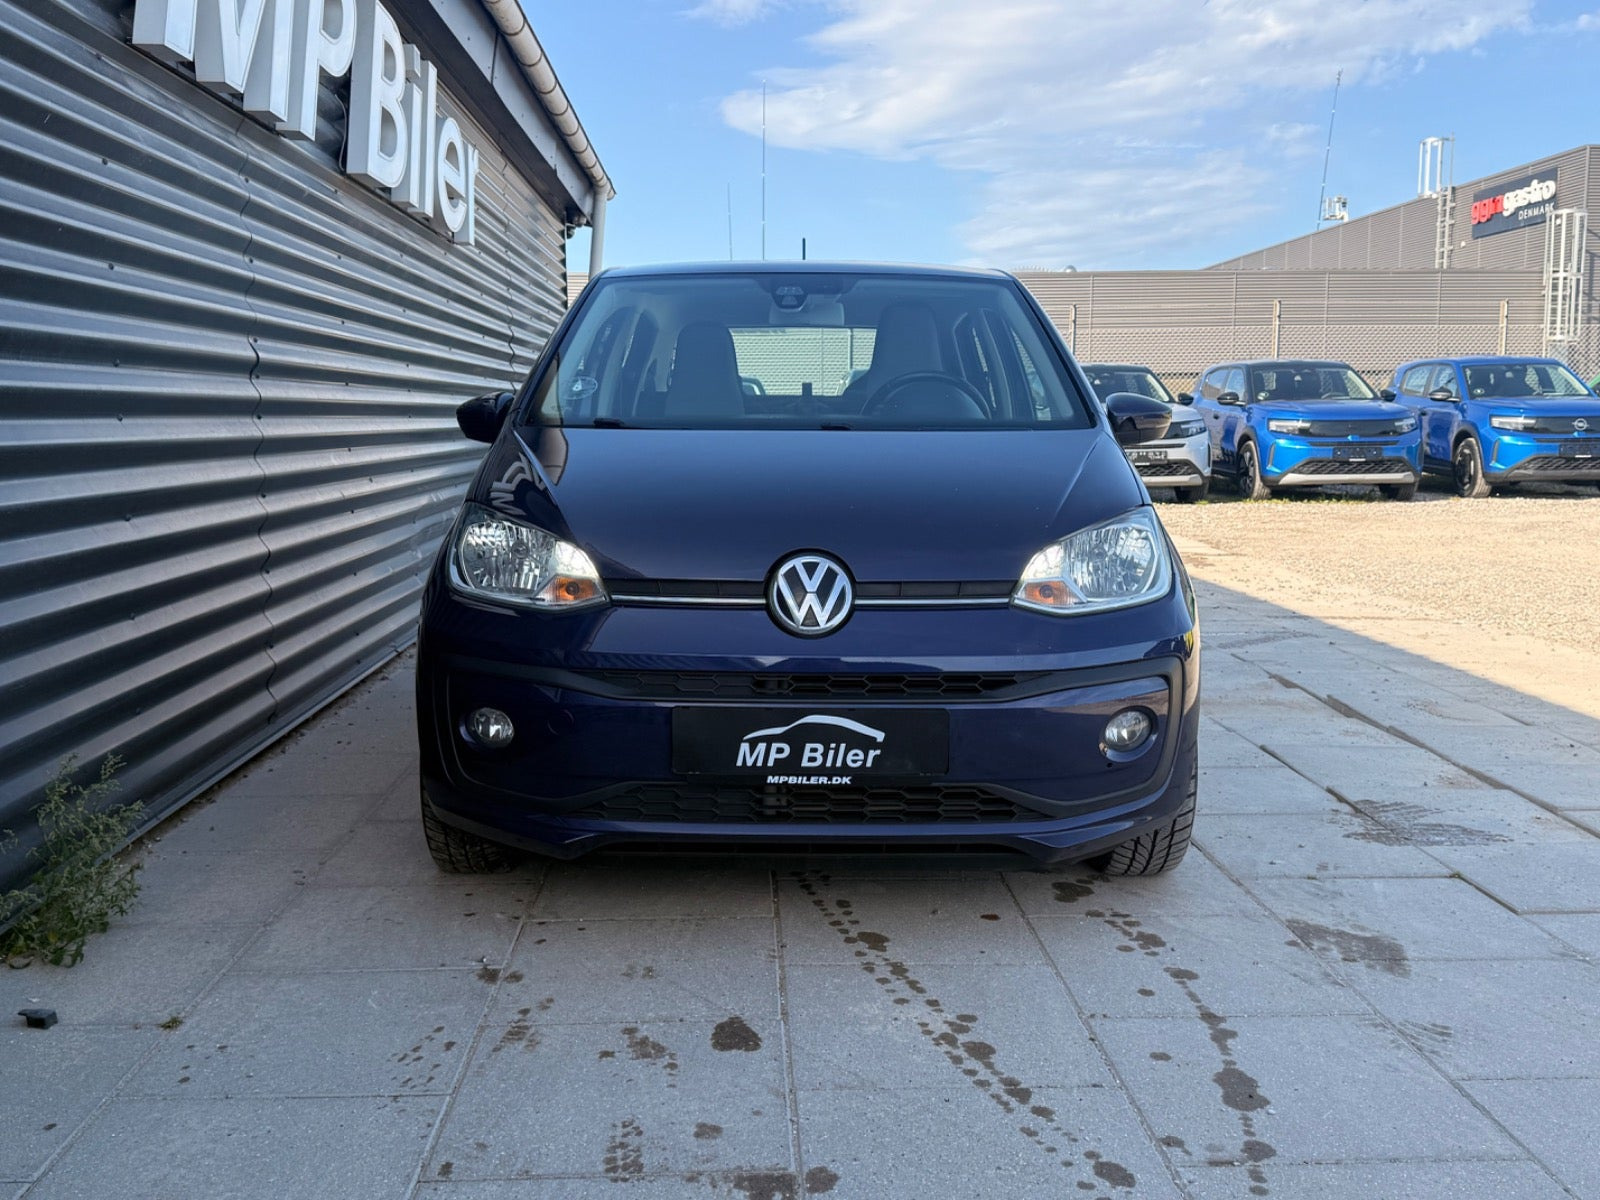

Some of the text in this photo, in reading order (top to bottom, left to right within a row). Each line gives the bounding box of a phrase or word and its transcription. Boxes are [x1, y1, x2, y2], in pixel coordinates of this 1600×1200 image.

[347, 0, 479, 246] Biler
[1518, 202, 1555, 220] DENMARK
[736, 742, 881, 768] MP Biler
[766, 775, 852, 785] MPBILER.DK
